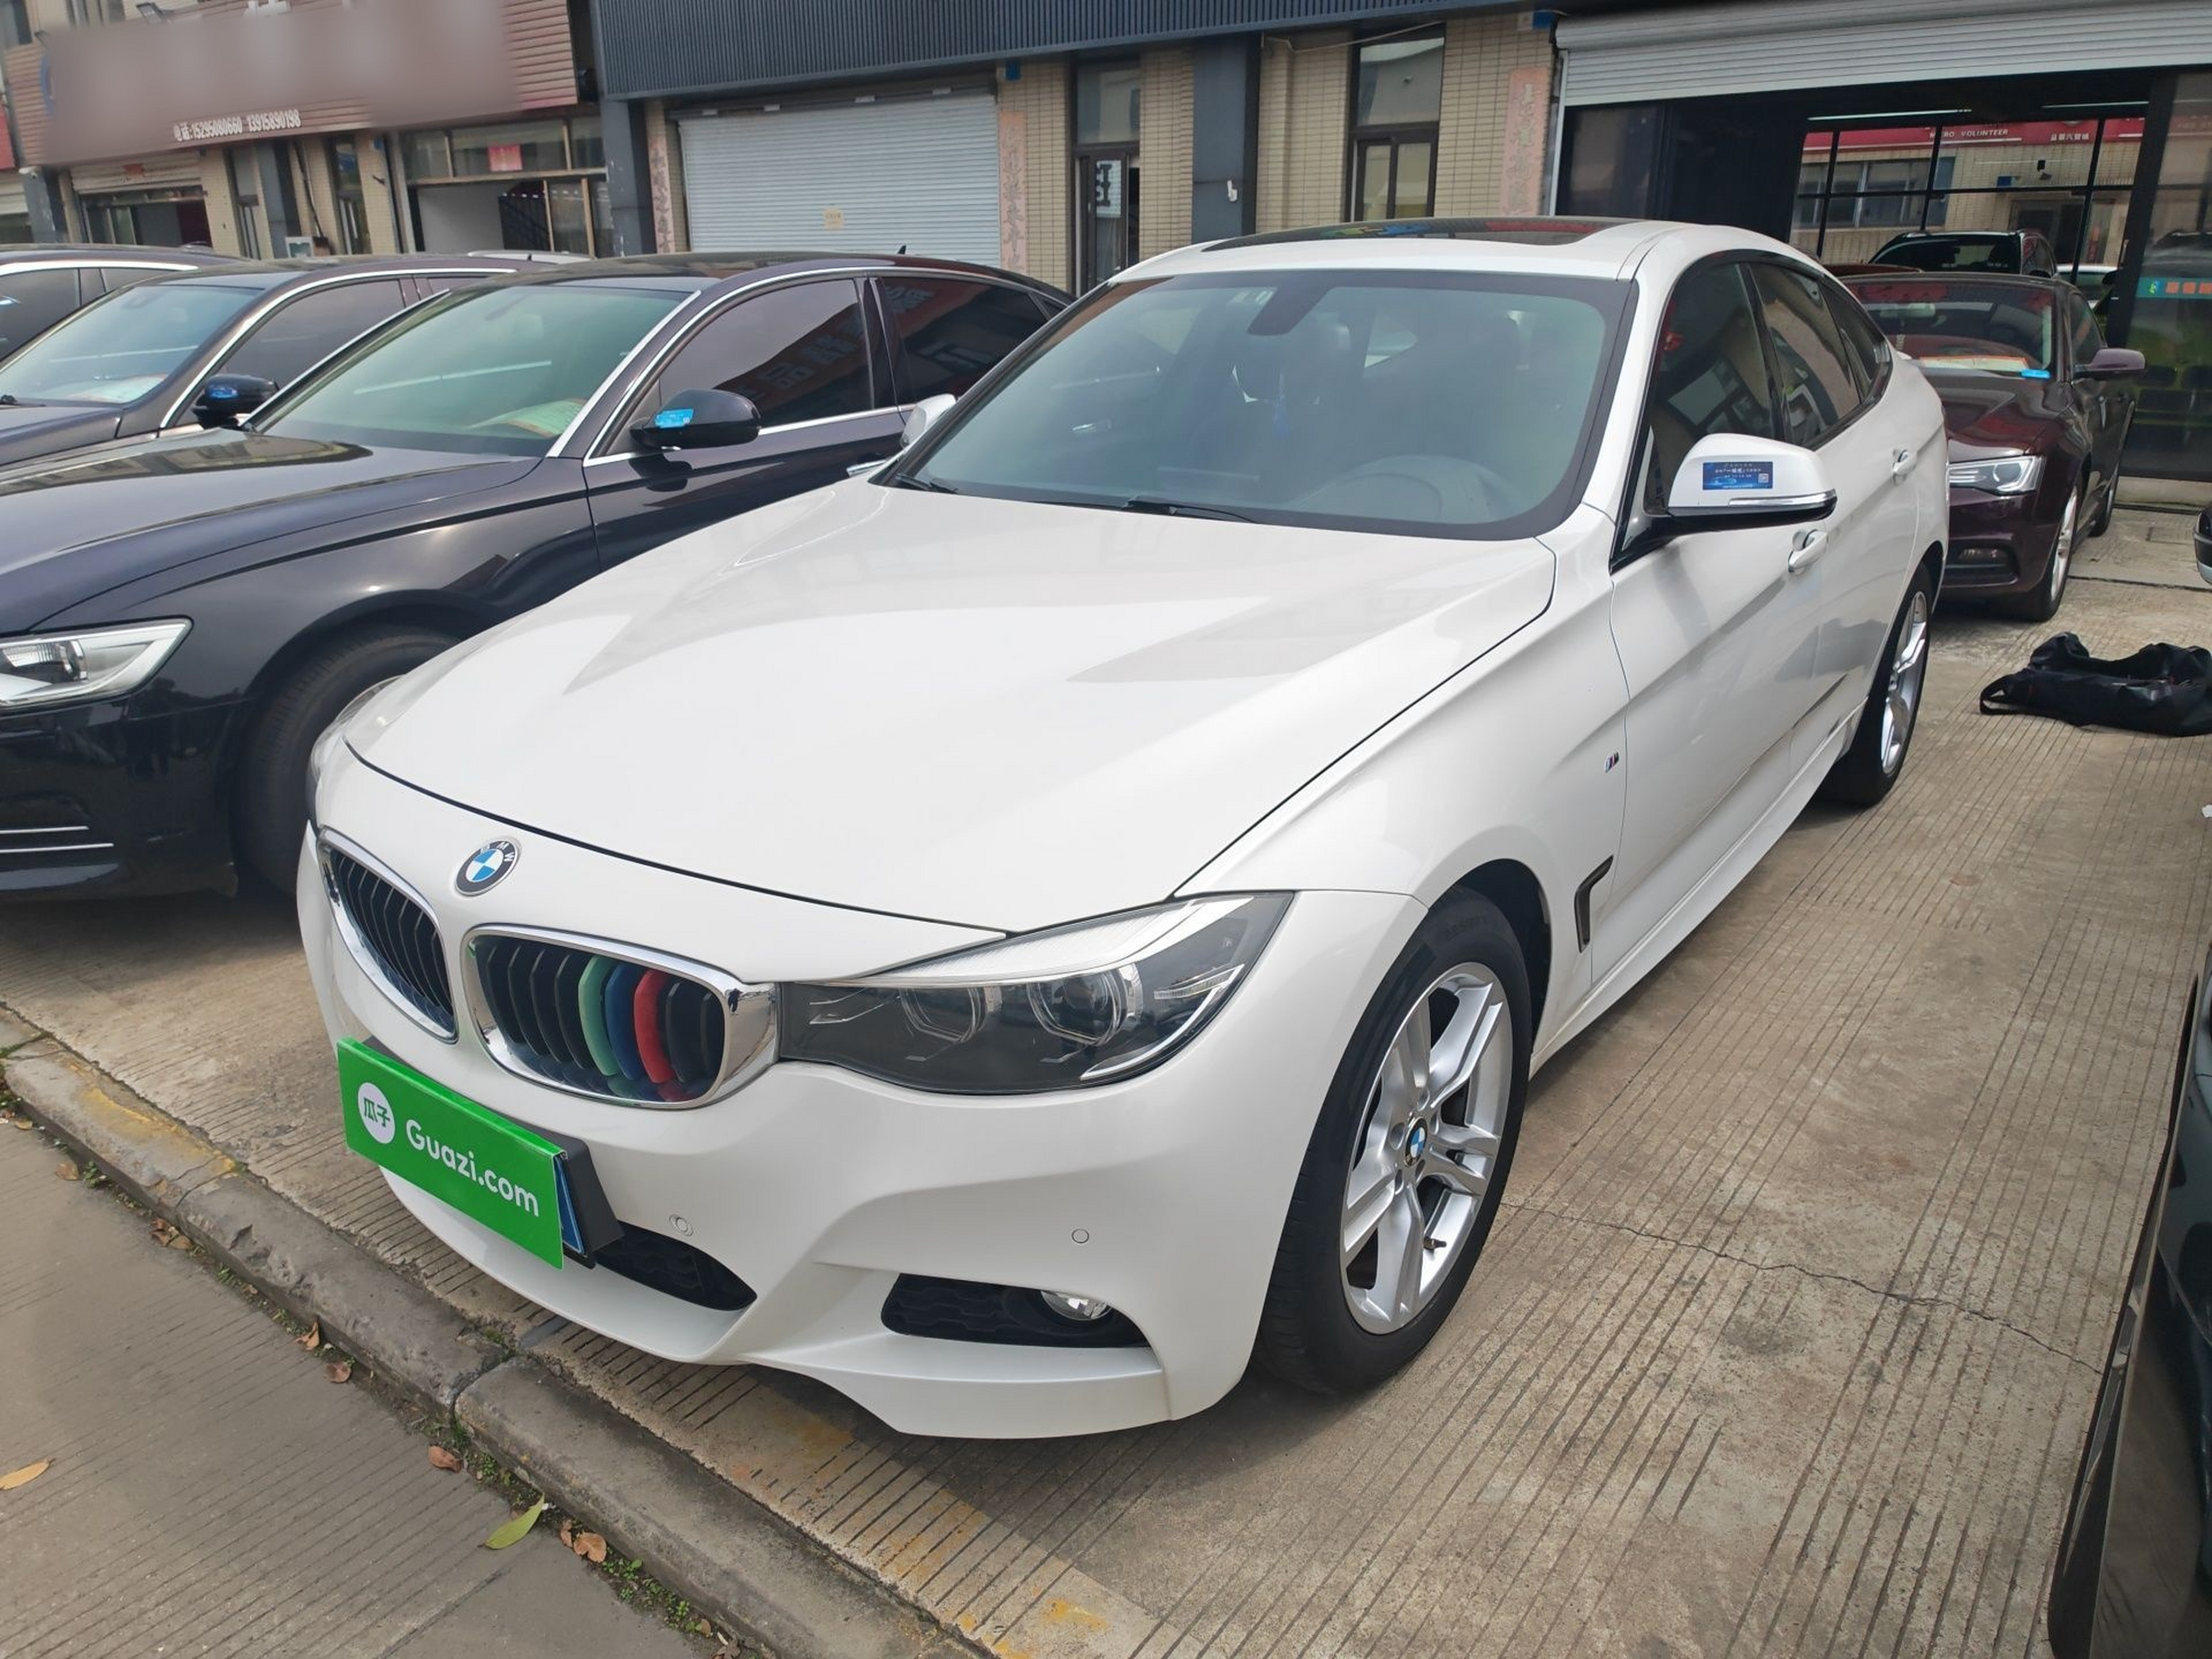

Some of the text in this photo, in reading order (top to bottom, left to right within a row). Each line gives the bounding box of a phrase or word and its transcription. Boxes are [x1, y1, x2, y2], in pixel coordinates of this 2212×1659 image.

[247, 109, 301, 132] 13915890198
[1930, 128, 2009, 139] MRO VOLUNTEER
[363, 1096, 391, 1127] 瓜子
[406, 1119, 539, 1217] Guazi.com
